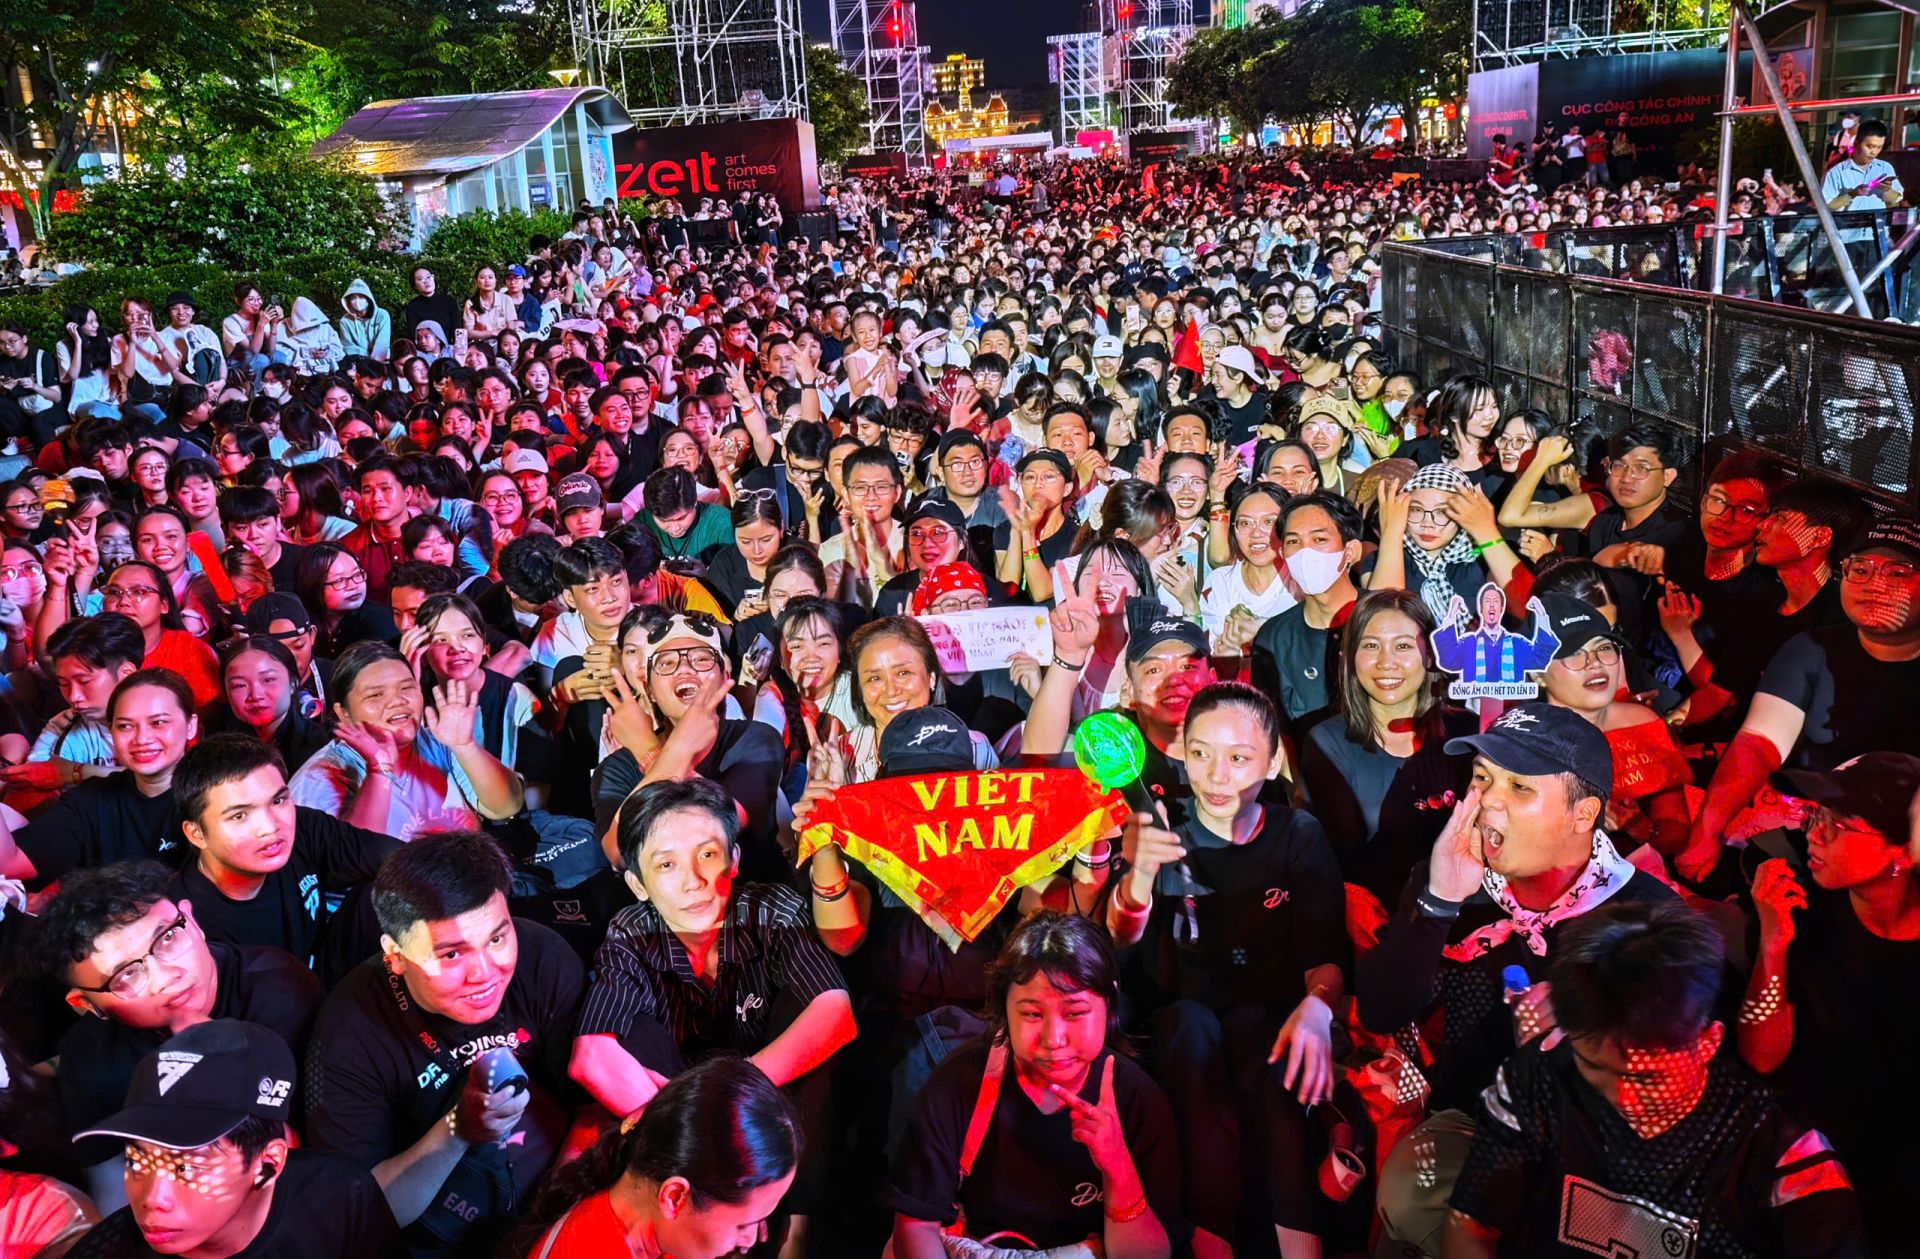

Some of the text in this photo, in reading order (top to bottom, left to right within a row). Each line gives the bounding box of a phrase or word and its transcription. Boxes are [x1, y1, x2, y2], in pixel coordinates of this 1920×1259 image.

[1562, 103, 1591, 117] CỤC
[1594, 99, 1635, 114] CÔNG
[1638, 96, 1664, 110] TÁC
[1666, 93, 1711, 109] CHÍNH
[1629, 114, 1670, 128] CÔNG
[1674, 112, 1695, 124] AN
[725, 153, 746, 166] art
[726, 164, 777, 177] comes
[969, 172, 987, 180] EXIT
[727, 178, 757, 191] first
[1128, 267, 1141, 275] 114
[558, 480, 592, 498] Orlando
[1507, 686, 1516, 695] TO
[910, 770, 1045, 811] VIỆT
[913, 814, 1035, 863] NAM
